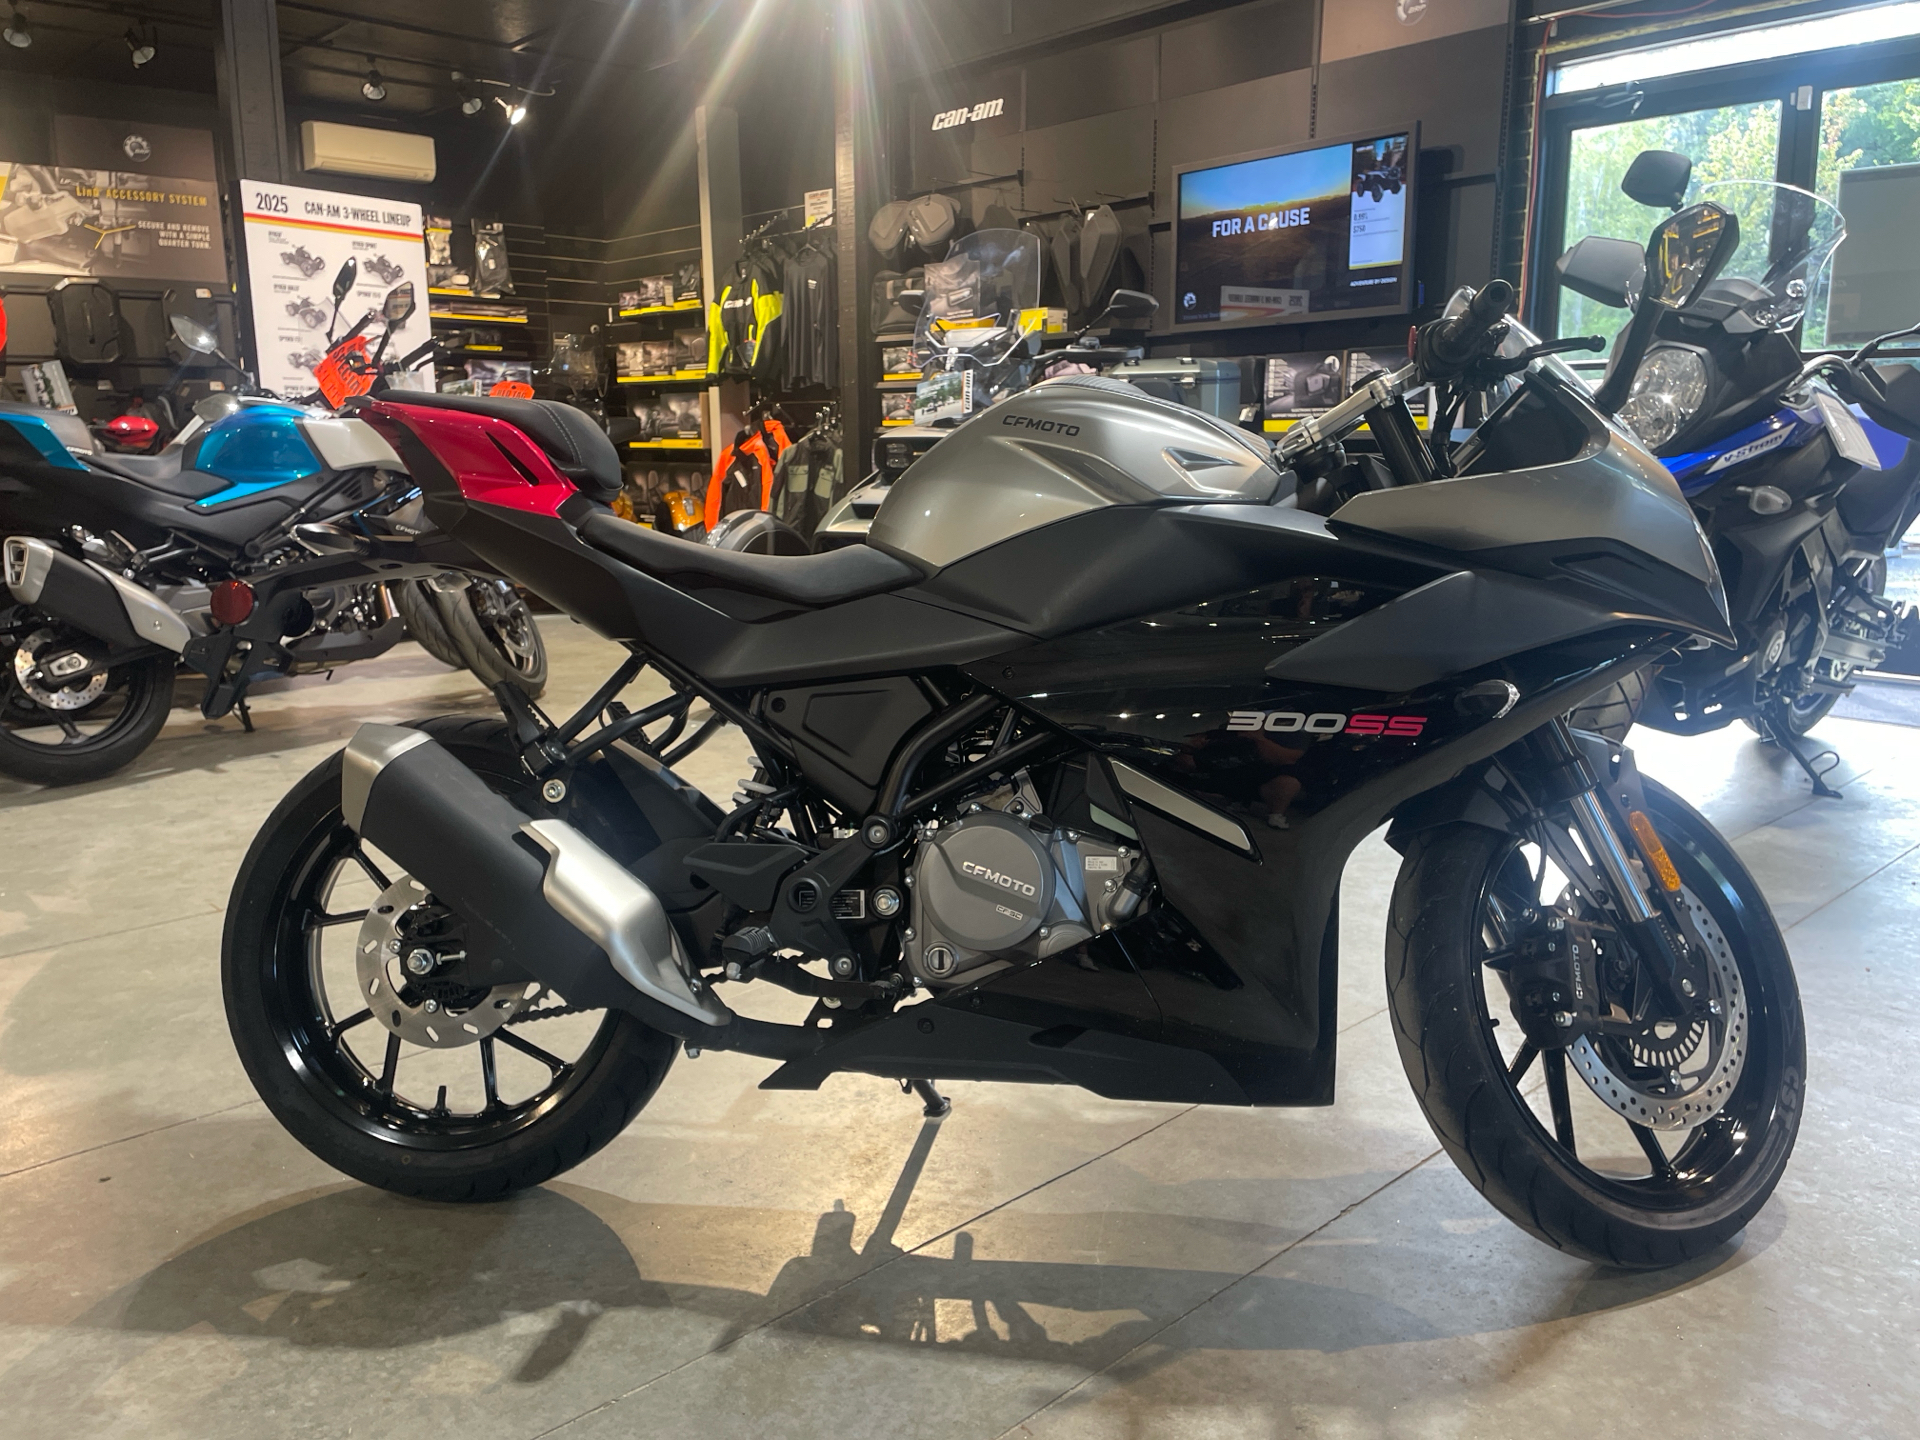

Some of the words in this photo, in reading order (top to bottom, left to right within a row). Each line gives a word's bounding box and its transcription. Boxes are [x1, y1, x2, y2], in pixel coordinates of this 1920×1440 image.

[931, 98, 1004, 131] can-am
[106, 188, 166, 203] ACCESSORY
[169, 194, 207, 207] SYSTEM
[255, 192, 289, 213] 2025
[138, 221, 165, 231] SECURE
[167, 223, 180, 231] AND
[182, 224, 210, 233] REMOVE
[304, 201, 340, 219] CAN-AM
[343, 206, 381, 223] 3-WHEEL
[382, 212, 412, 227] LINEUP
[1212, 217, 1242, 238] FOR
[1243, 216, 1255, 234] A
[1257, 207, 1310, 231] CAUSE
[158, 239, 189, 248] QUARTER
[191, 240, 212, 249] TURN.
[159, 231, 177, 239] WITH
[186, 232, 211, 242] SIMPLE
[1002, 414, 1081, 437] CFMOTO
[1226, 710, 1428, 736] 300SS
[962, 861, 1035, 897] CFMOTO
[1572, 944, 1584, 1000] CFMOTO
[1777, 1065, 1799, 1131] CST
